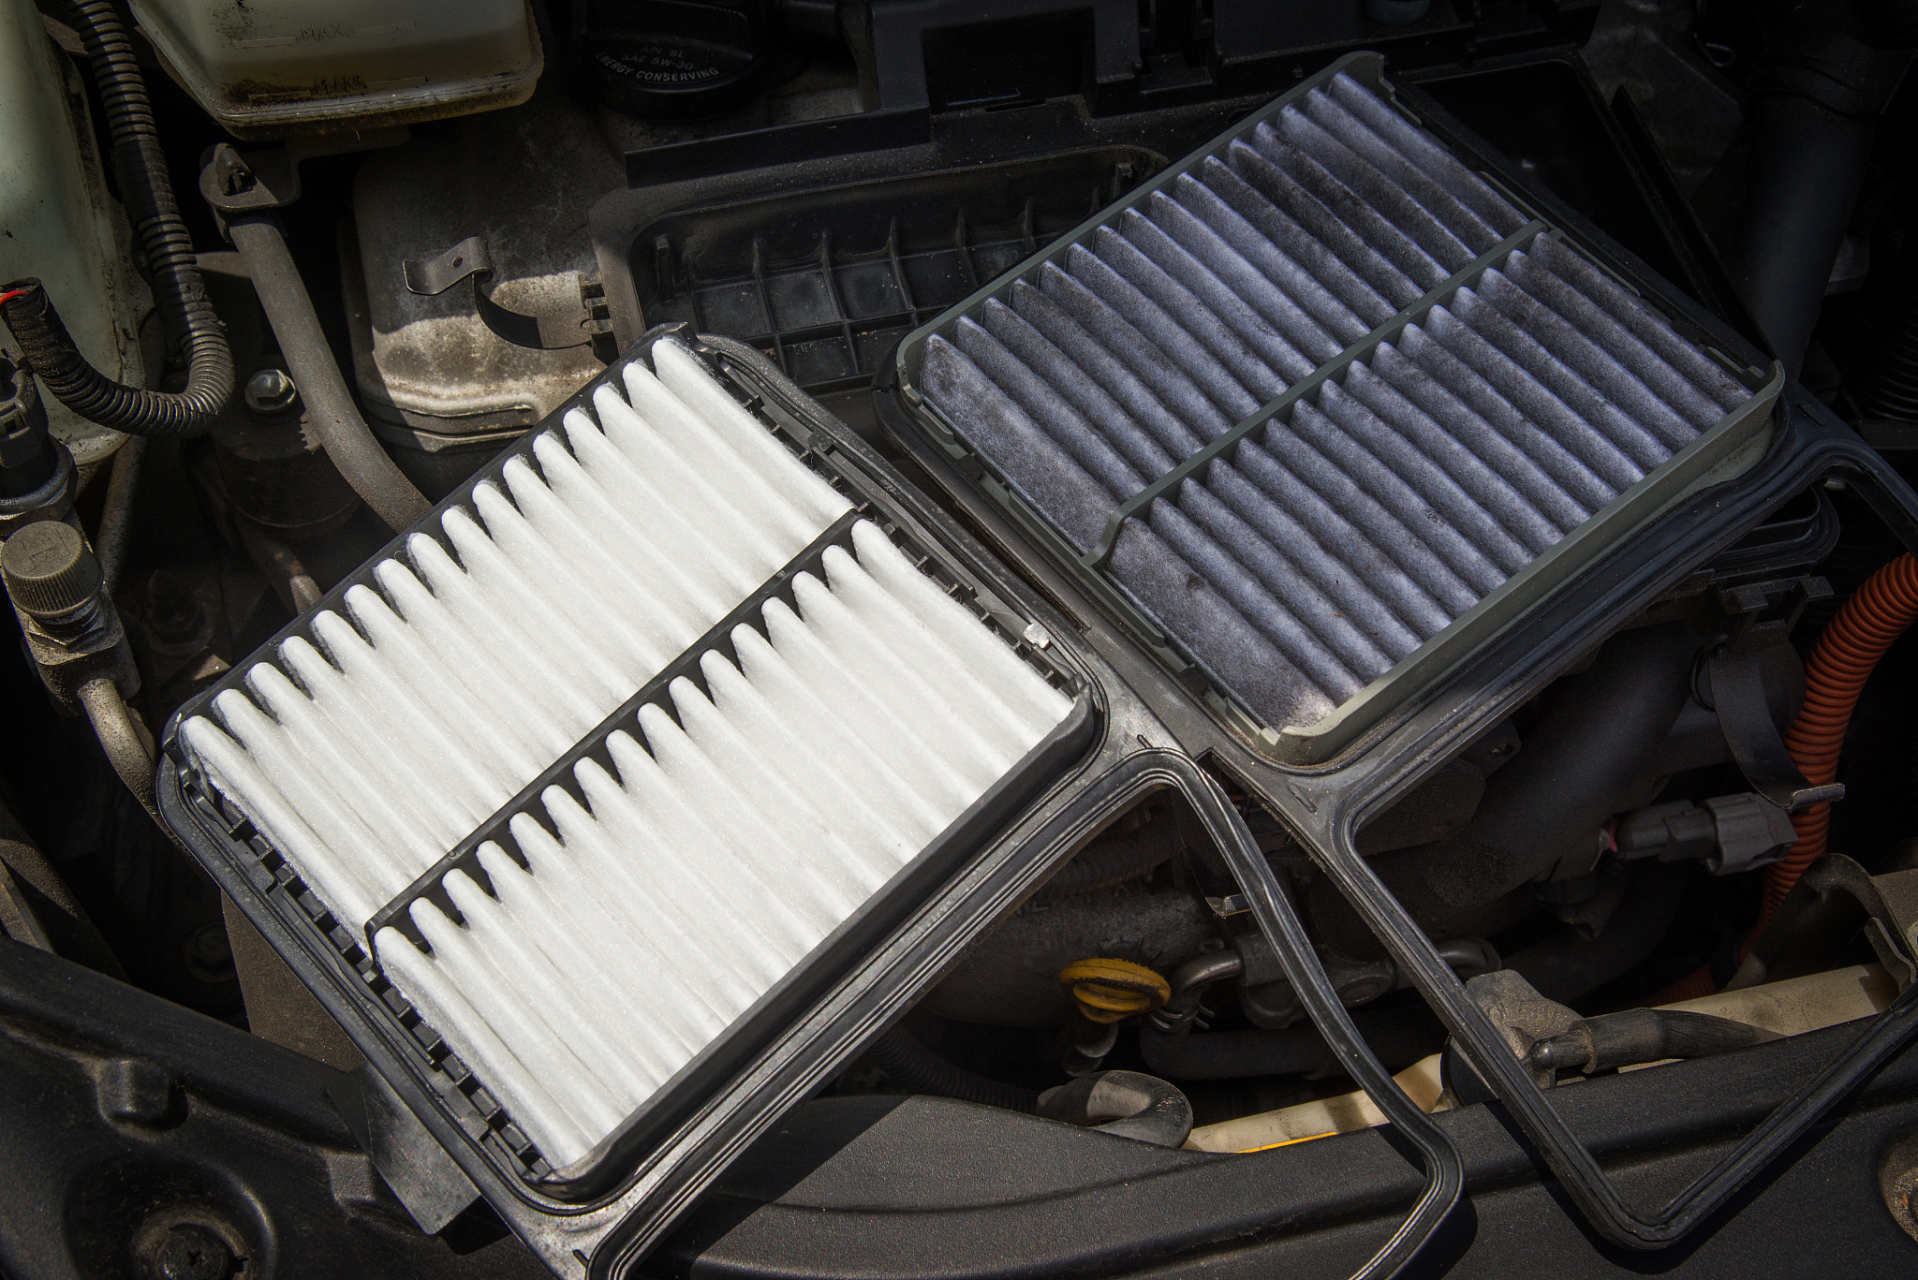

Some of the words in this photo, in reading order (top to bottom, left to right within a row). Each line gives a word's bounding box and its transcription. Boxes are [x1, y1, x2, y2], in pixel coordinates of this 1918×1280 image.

[300, 20, 349, 41] MAX
[621, 53, 647, 63] SAE
[651, 57, 694, 70] 5W-30
[669, 50, 685, 58] SL
[595, 52, 634, 75] ENERGY
[635, 67, 720, 82] CONSERVING
